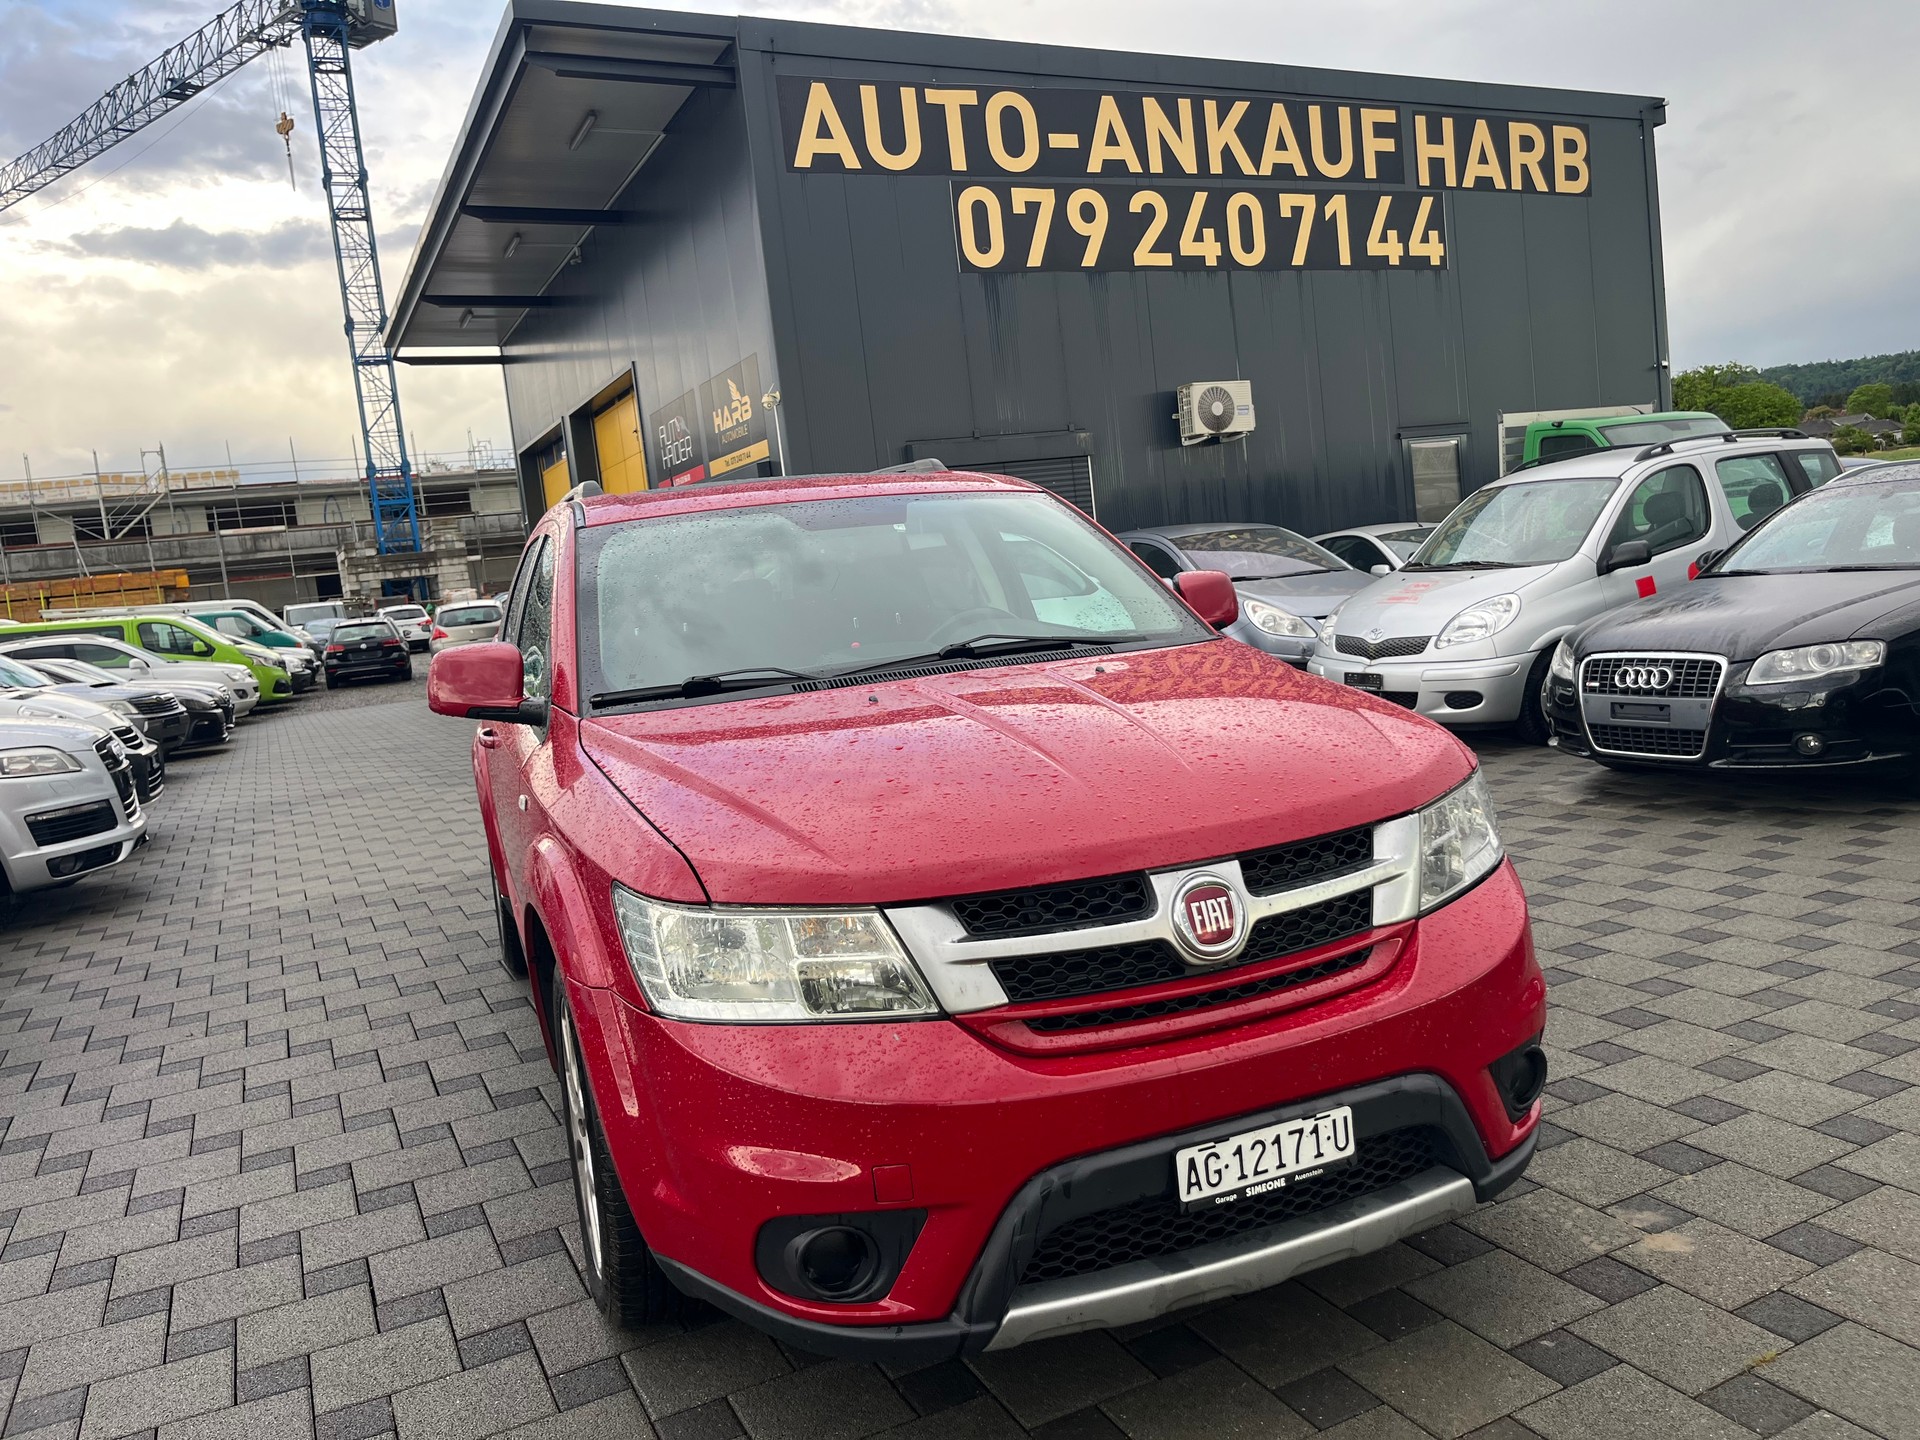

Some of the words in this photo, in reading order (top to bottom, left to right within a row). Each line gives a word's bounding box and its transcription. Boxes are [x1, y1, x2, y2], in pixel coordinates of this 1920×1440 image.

[793, 82, 1397, 179] AUTO-ANKAUF
[1414, 115, 1590, 194] HARB
[712, 395, 752, 434] HARB
[1190, 896, 1232, 934] FIAT
[1215, 1193, 1238, 1204] Garage
[1245, 1177, 1287, 1197] SIMEONE
[1294, 1168, 1324, 1181] Auenstein
